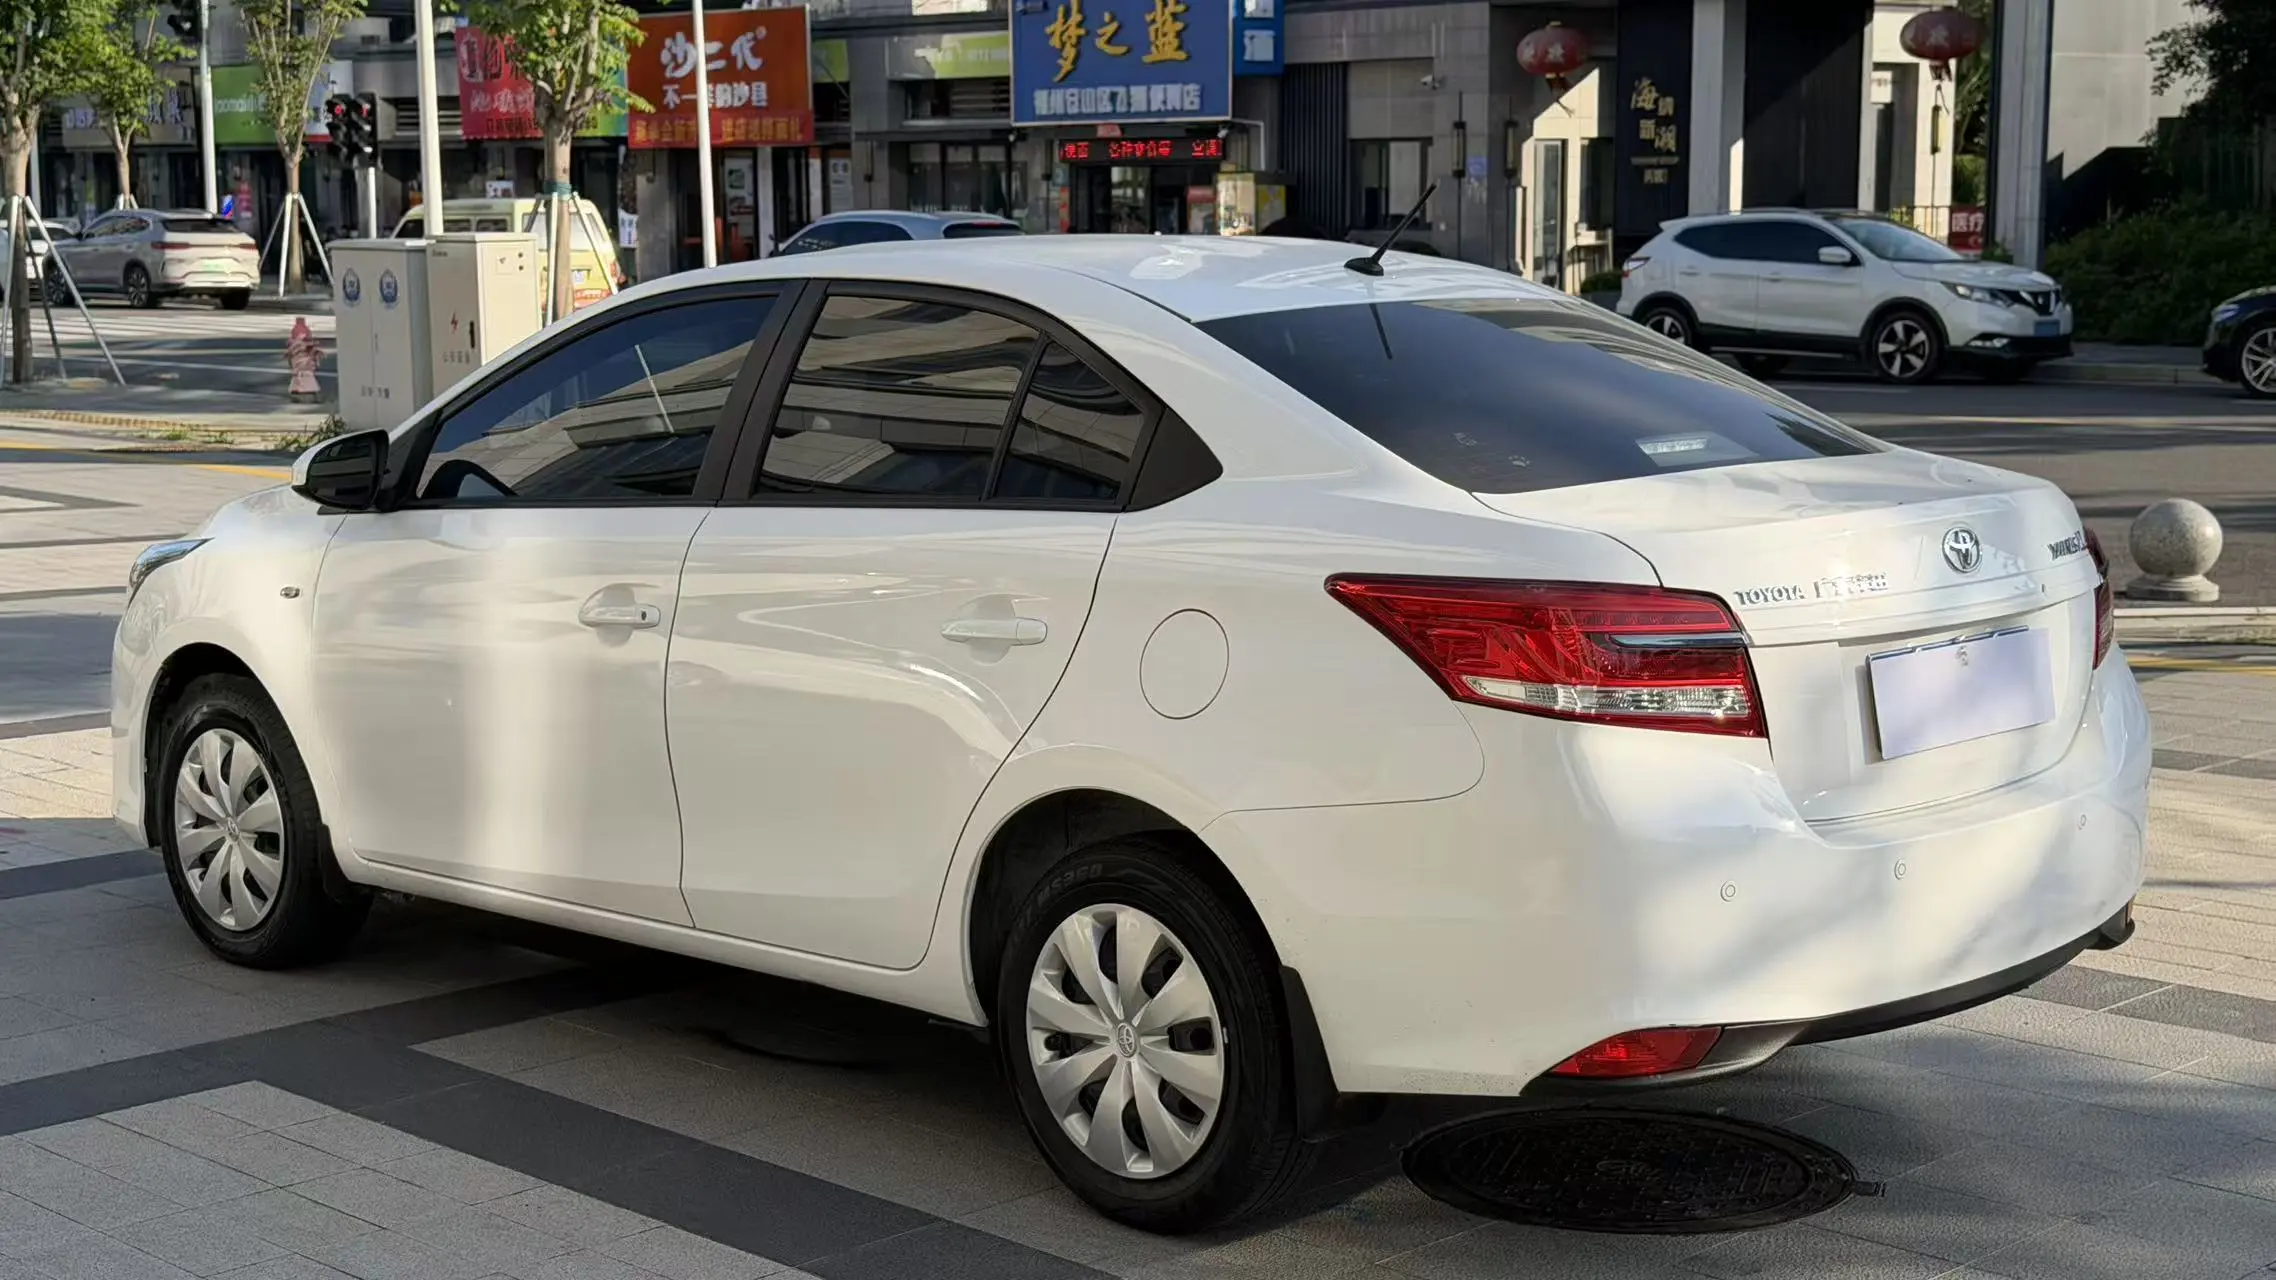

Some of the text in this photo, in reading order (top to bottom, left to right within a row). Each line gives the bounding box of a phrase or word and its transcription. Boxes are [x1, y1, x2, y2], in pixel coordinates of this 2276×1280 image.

[660, 32, 763, 79] 沙二代
[1044, 0, 1189, 83] 梦之蓝
[1733, 583, 1806, 606] TOYOTA
